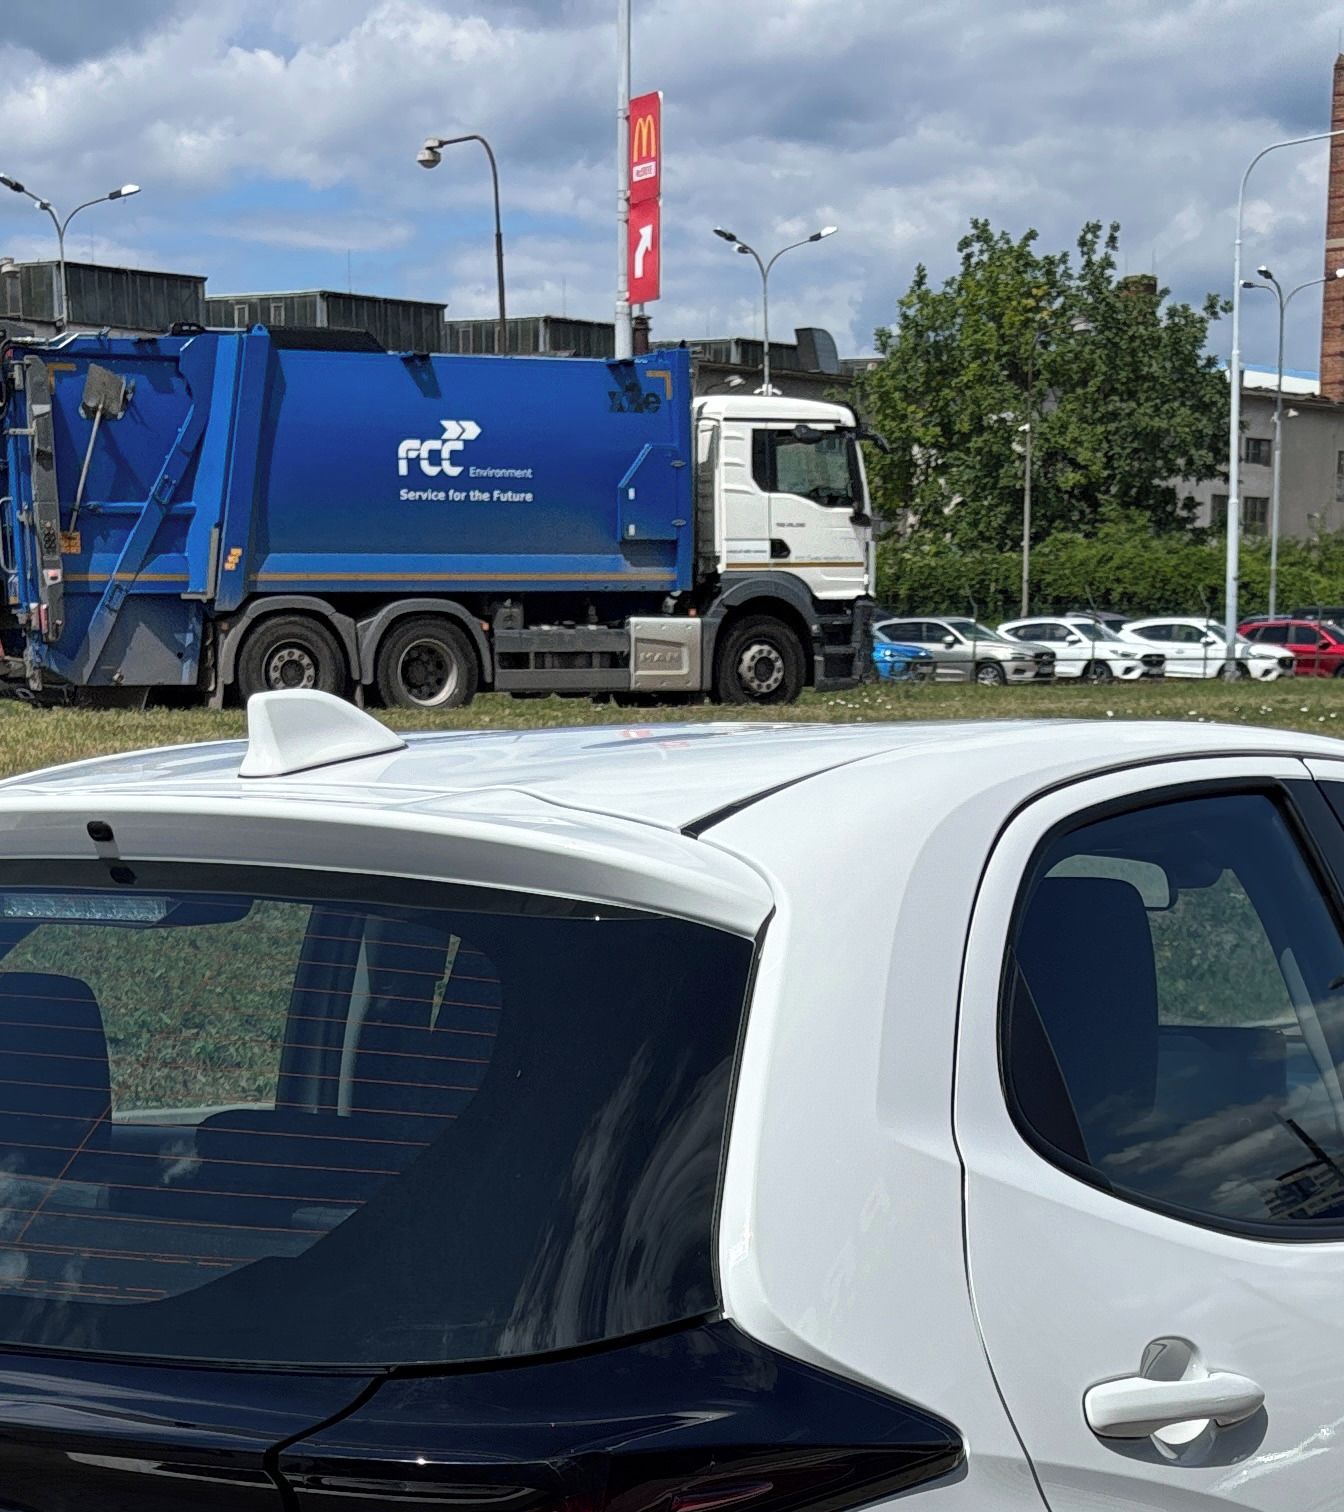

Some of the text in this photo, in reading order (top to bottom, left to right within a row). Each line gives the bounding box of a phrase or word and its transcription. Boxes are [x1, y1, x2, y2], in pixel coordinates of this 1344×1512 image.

[398, 439, 533, 479] FCC Environment
[399, 489, 534, 501] Service for the Future
